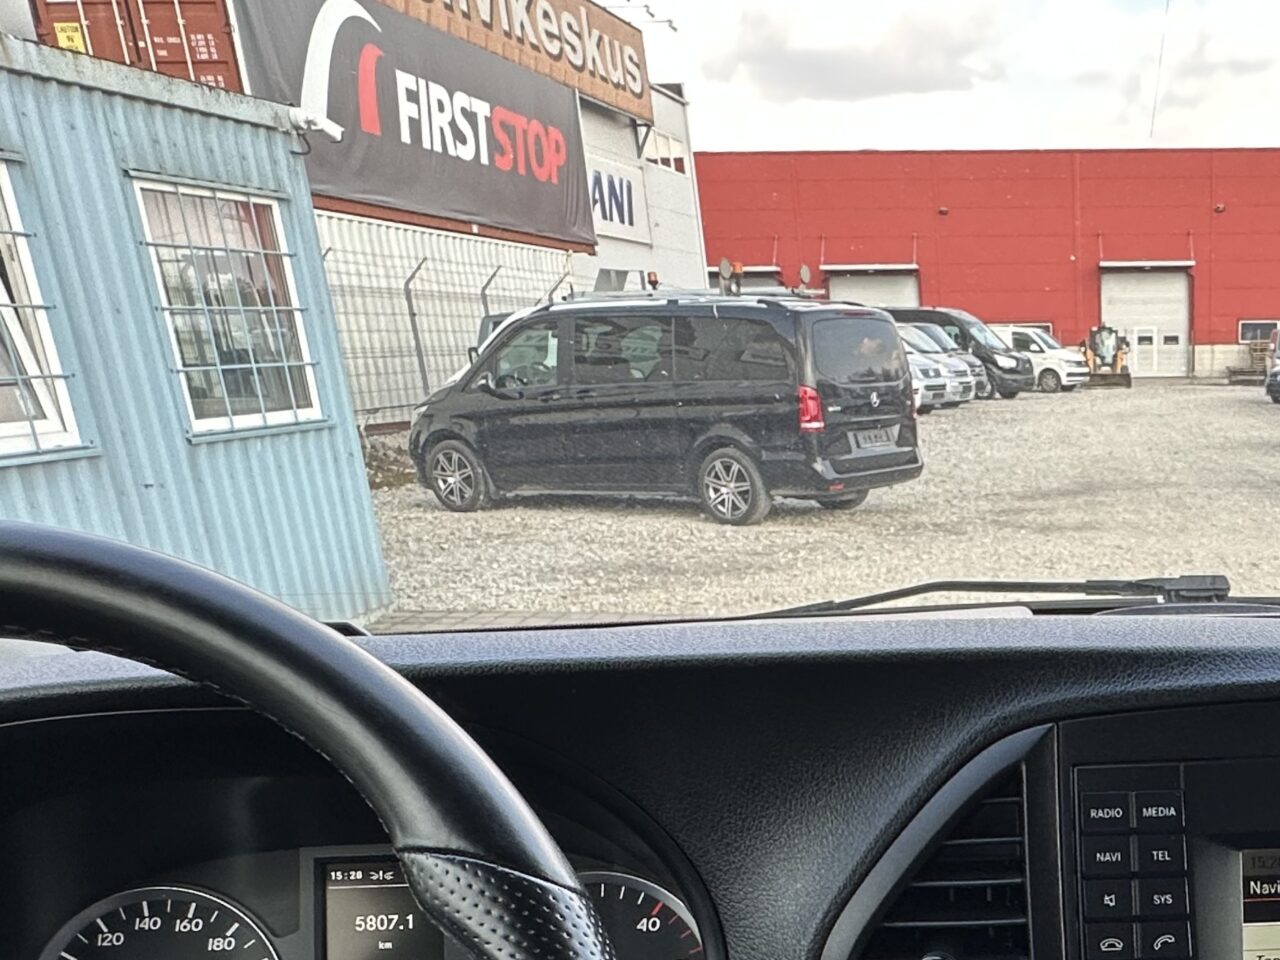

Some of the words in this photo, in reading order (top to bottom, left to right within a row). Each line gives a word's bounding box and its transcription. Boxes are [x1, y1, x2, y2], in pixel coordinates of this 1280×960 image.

[1090, 807, 1123, 818] RADIO
[1142, 806, 1177, 818] MEDIA
[1095, 852, 1122, 862] NAVI
[1151, 850, 1172, 861] TEL
[1249, 880, 1280, 894] Navi
[1152, 894, 1173, 905] SYS
[134, 916, 162, 931] 140
[174, 918, 204, 932] 160
[354, 914, 414, 932] 5807.1
[636, 917, 661, 932] 40
[97, 932, 125, 947] 120
[208, 937, 236, 951] 180
[378, 940, 393, 950] km
